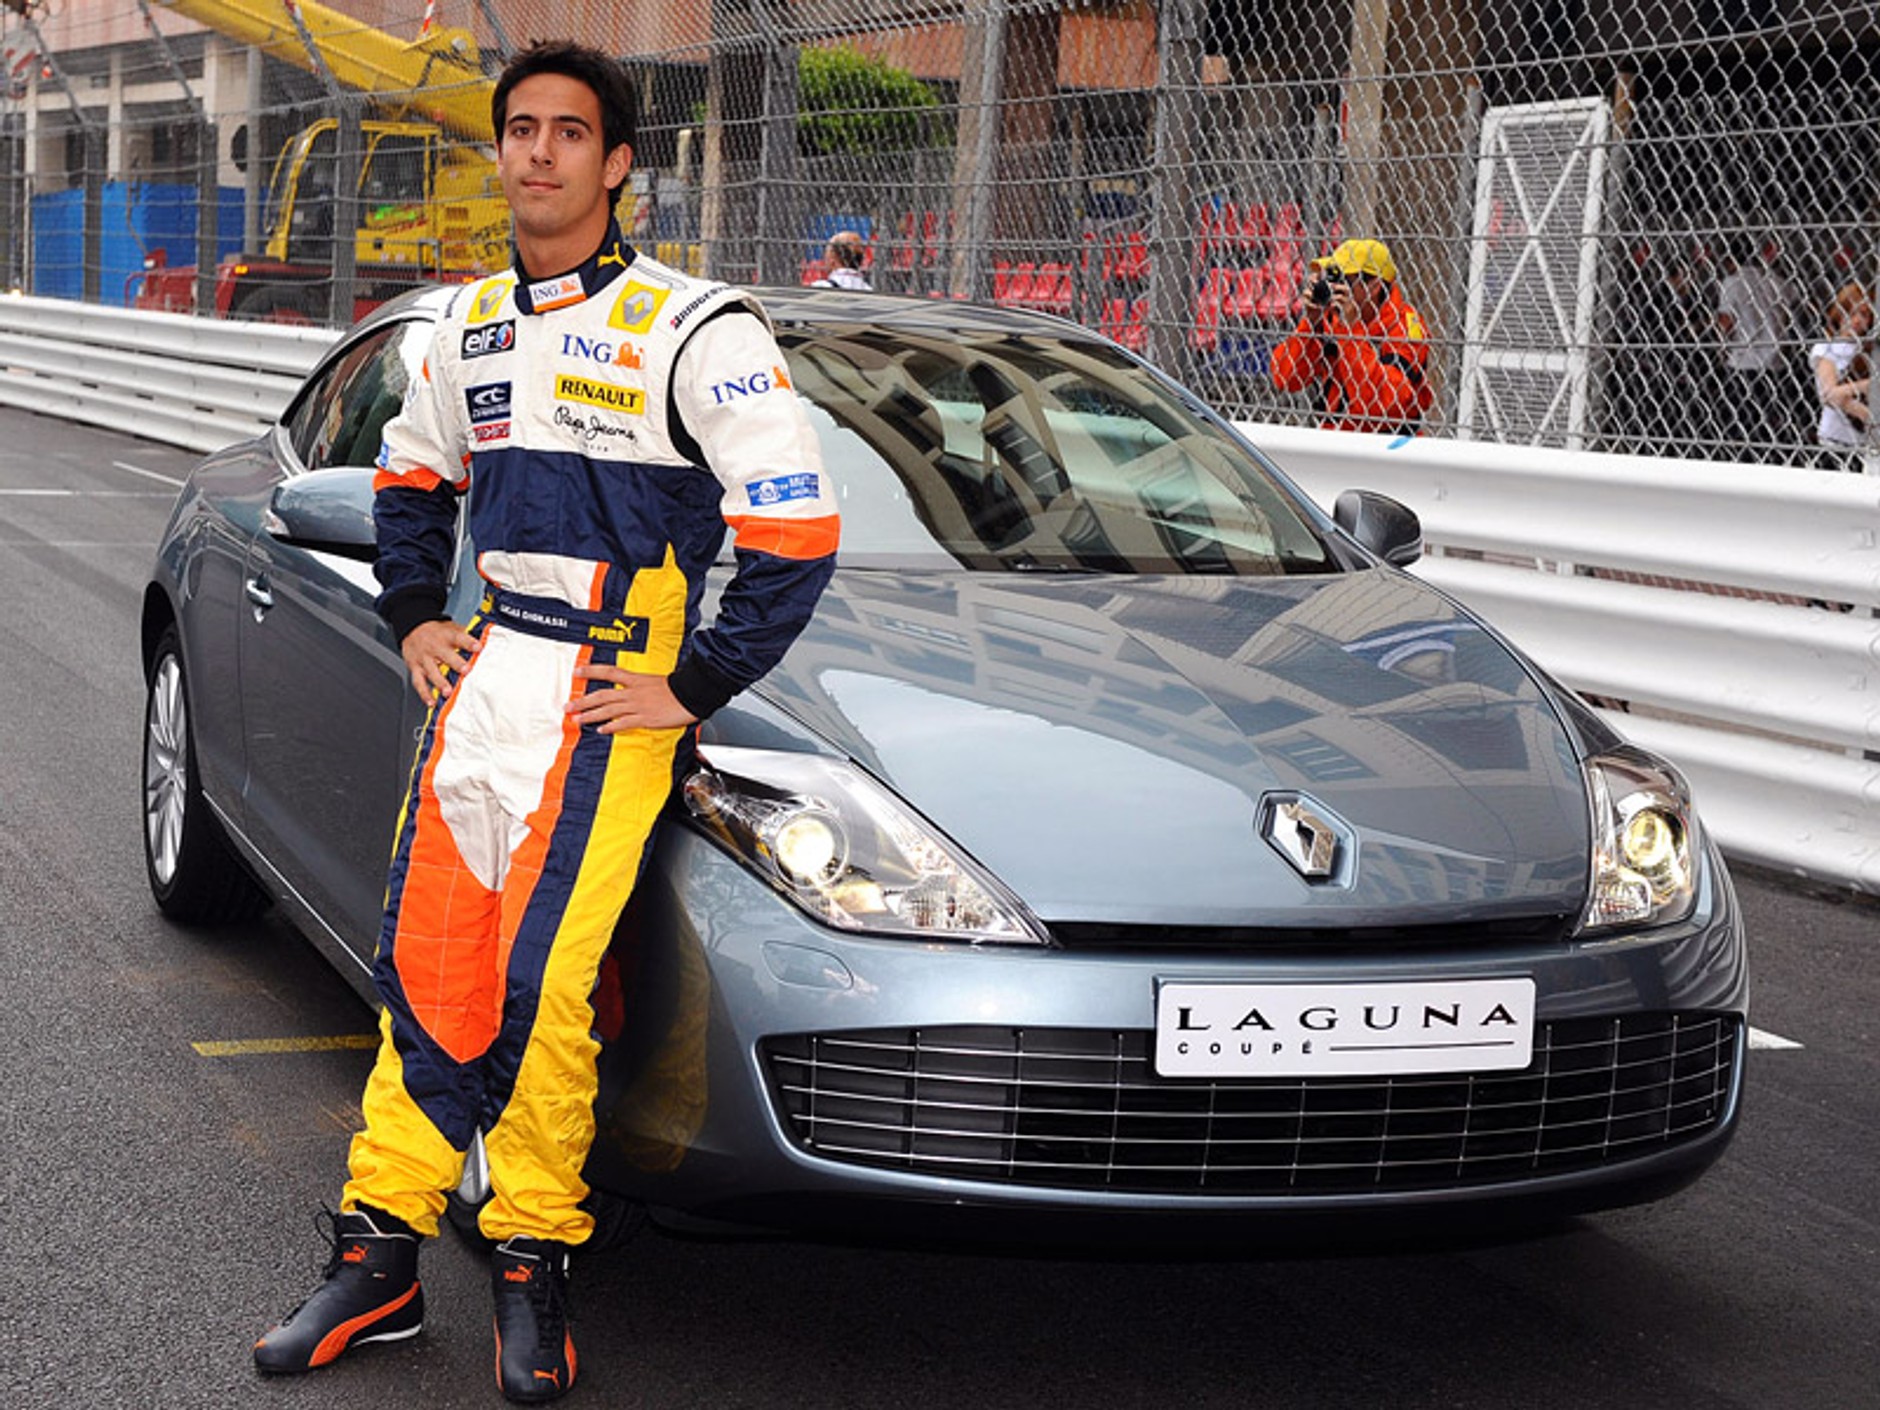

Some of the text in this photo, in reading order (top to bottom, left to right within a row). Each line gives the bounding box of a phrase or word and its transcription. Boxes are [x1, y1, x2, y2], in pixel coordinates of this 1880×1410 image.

[533, 285, 559, 301] ING
[465, 328, 497, 351] elf
[561, 333, 613, 363] ING
[560, 378, 640, 408] RENAULT
[711, 372, 771, 404] ING
[1176, 1003, 1518, 1031] LAGUNA
[1177, 1040, 1313, 1055] COUPÉ
